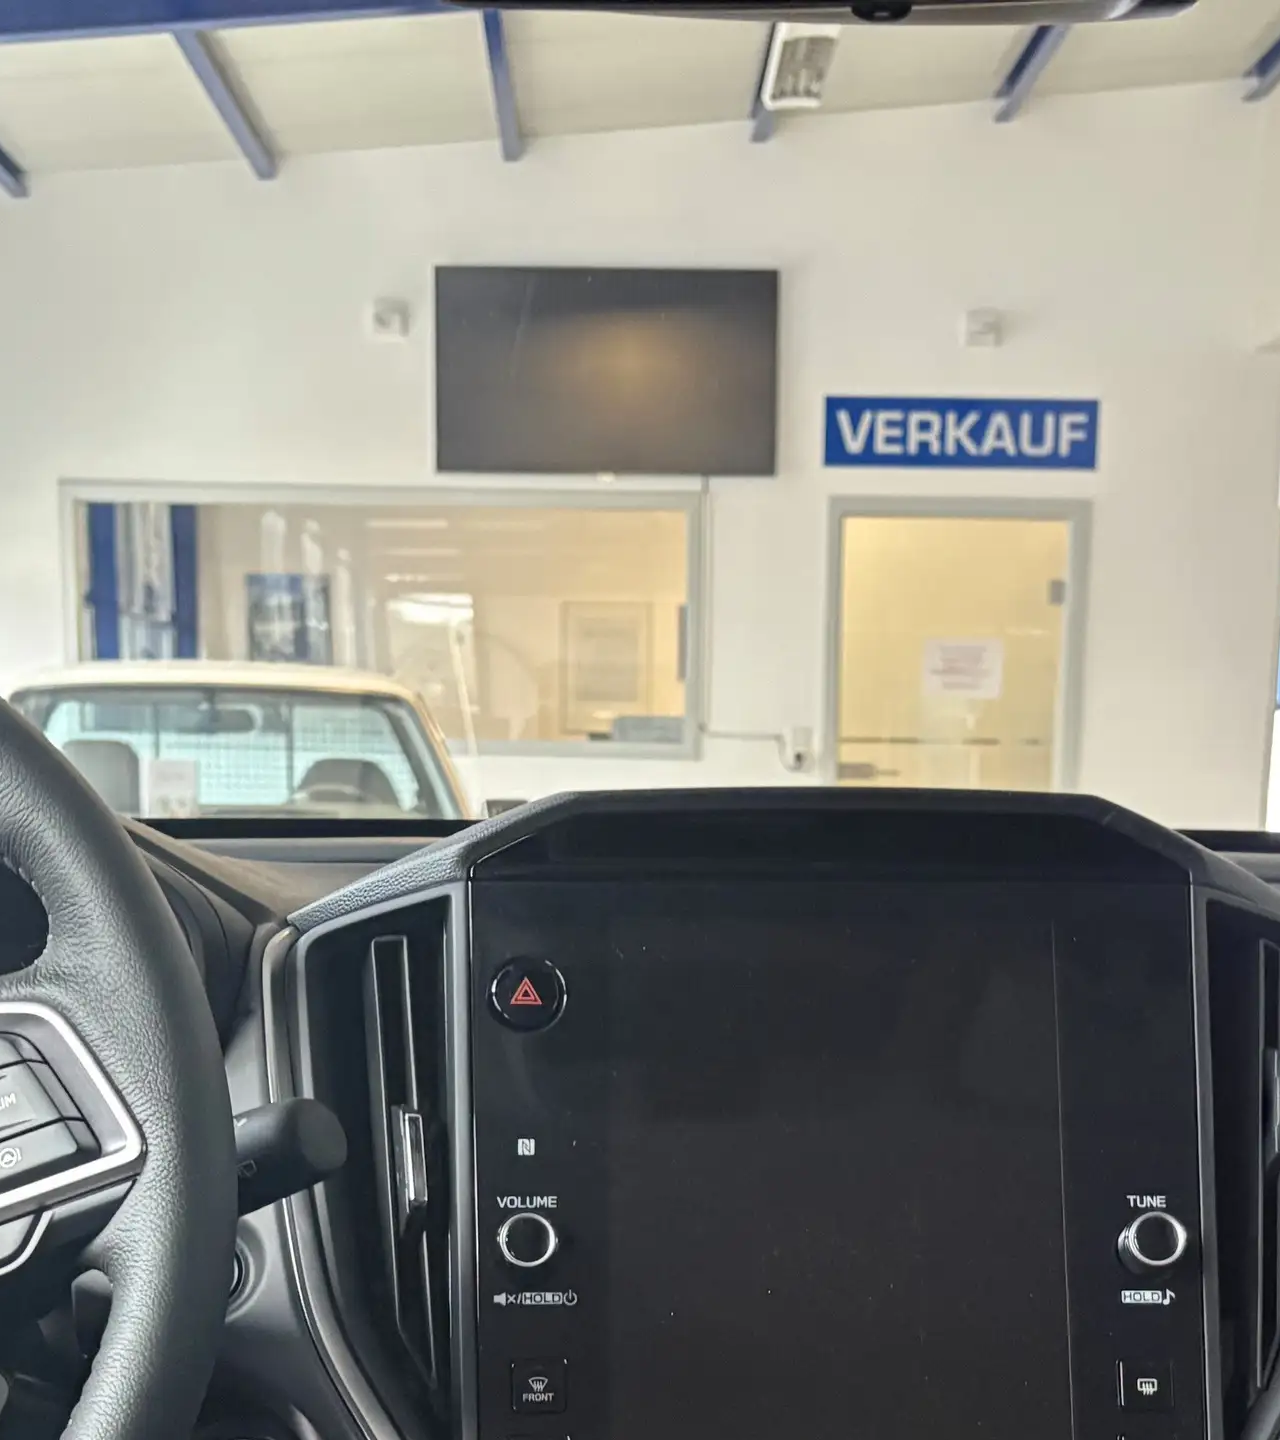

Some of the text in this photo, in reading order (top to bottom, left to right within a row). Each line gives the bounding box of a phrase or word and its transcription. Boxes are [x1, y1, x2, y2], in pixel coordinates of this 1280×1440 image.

[835, 408, 1090, 457] VERKAUF
[496, 1195, 558, 1209] VOLUME
[1126, 1195, 1167, 1208] TUNE
[522, 1292, 562, 1305] HOLD
[1122, 1290, 1162, 1303] HOLD
[523, 1393, 554, 1402] FRONT
